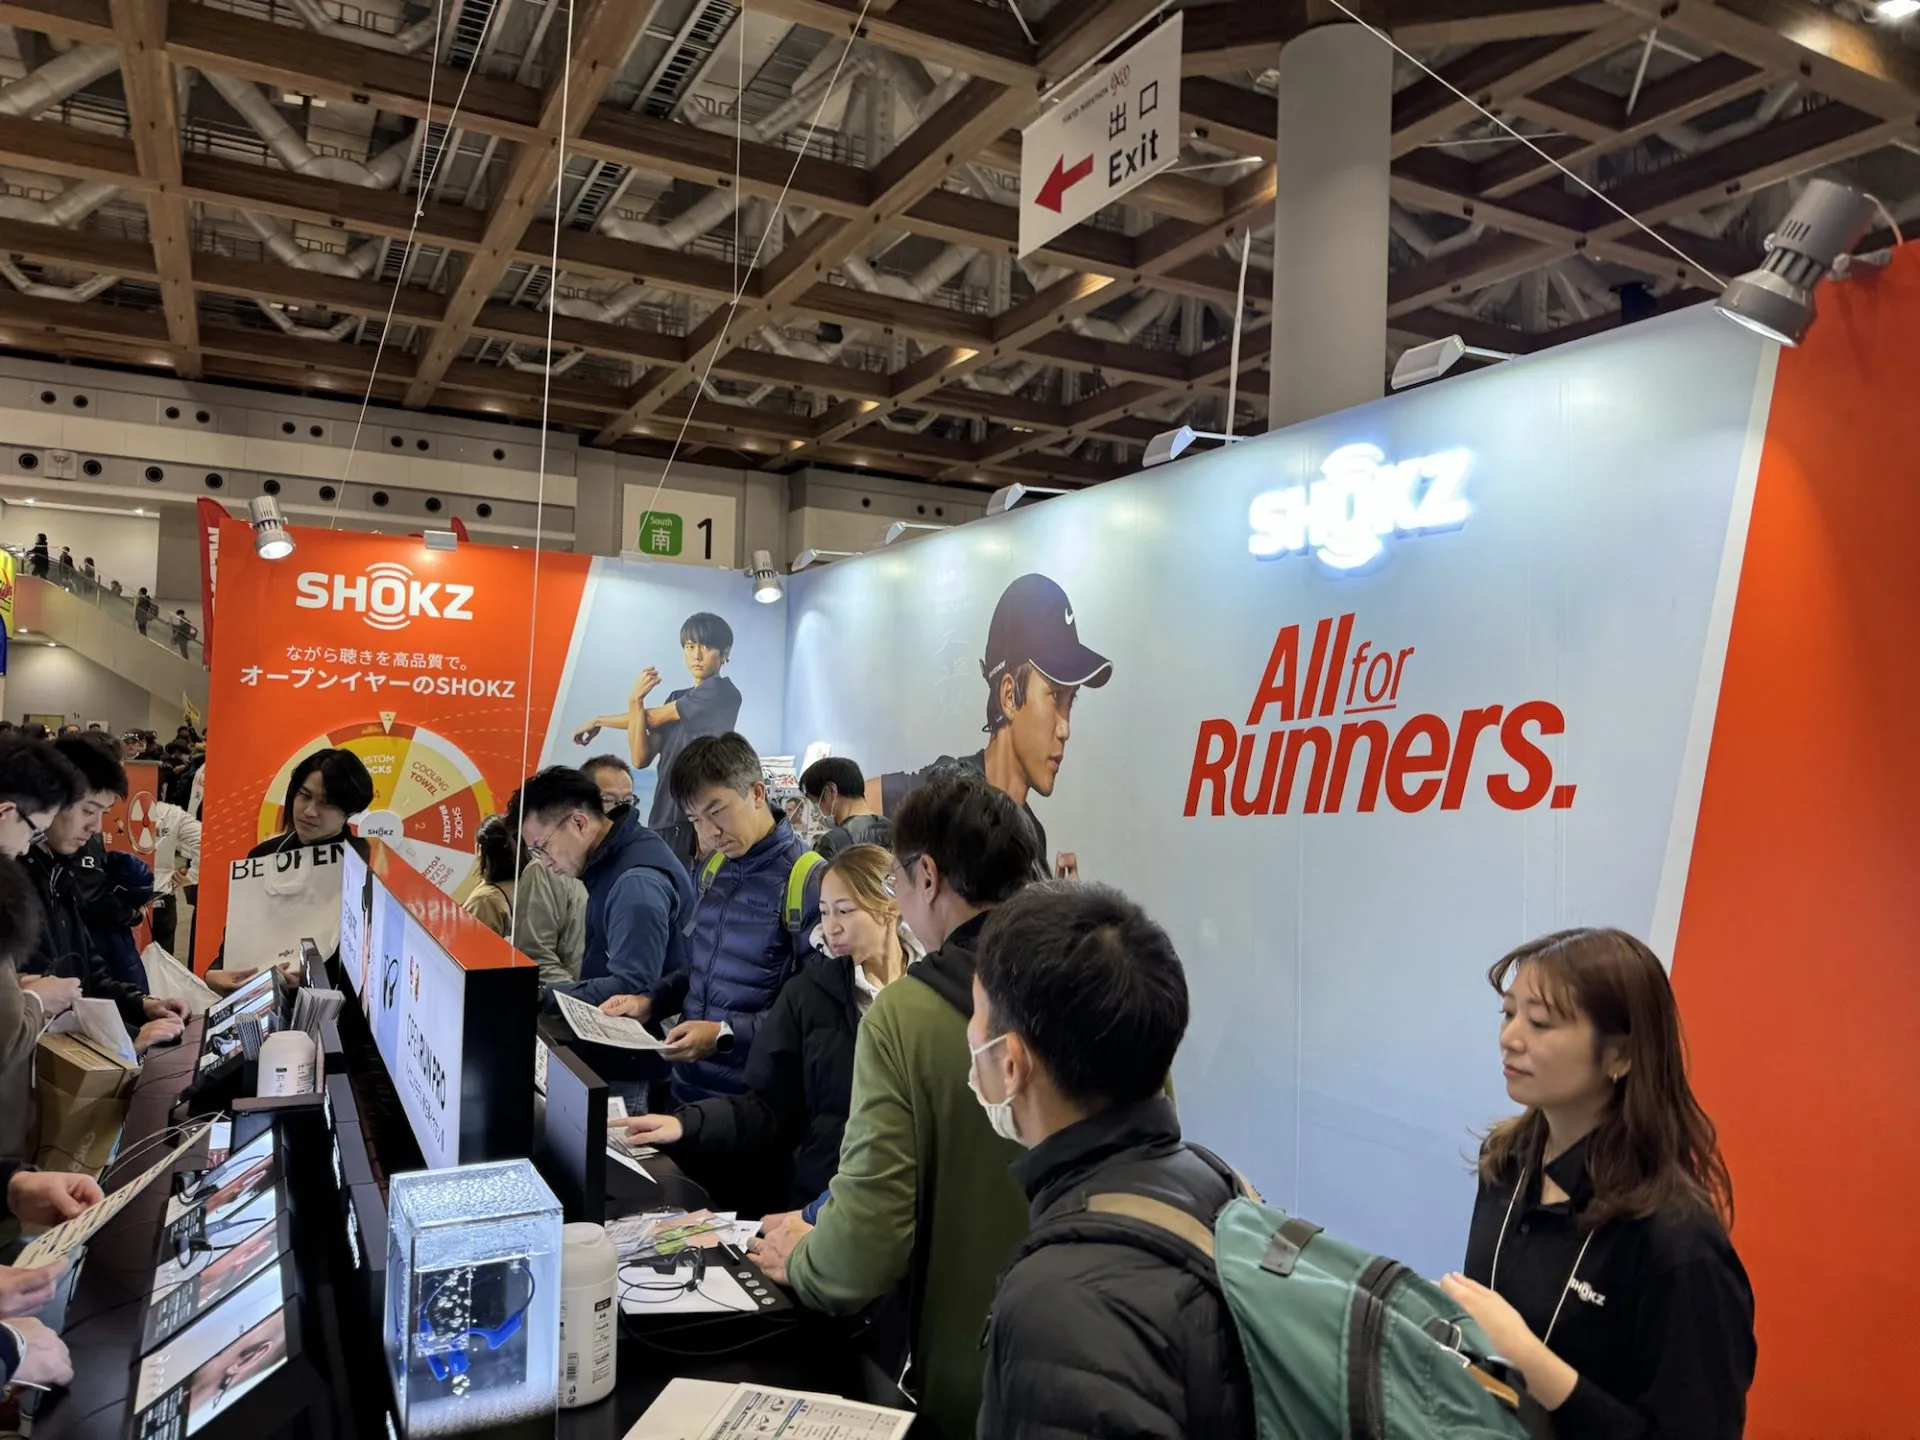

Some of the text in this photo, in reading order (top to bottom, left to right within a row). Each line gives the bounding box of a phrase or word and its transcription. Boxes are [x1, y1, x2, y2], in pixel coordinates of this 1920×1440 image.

[1109, 80, 1158, 141] 出口
[1109, 128, 1158, 188] Exit
[650, 515, 673, 527] South
[1248, 442, 1472, 569] SHOKZ
[651, 518, 713, 560] 南 1
[295, 562, 475, 631] SHOKZ
[286, 644, 468, 673] ながら聴きを高品質で。
[1246, 612, 1415, 726] All for
[240, 664, 516, 699] オープンイヤーのSHOKZ
[412, 761, 449, 792] COOLING
[1183, 700, 1578, 817] Runners.
[410, 771, 438, 797] TOWEL
[452, 806, 464, 840] SHOKZ
[231, 860, 264, 880] BE
